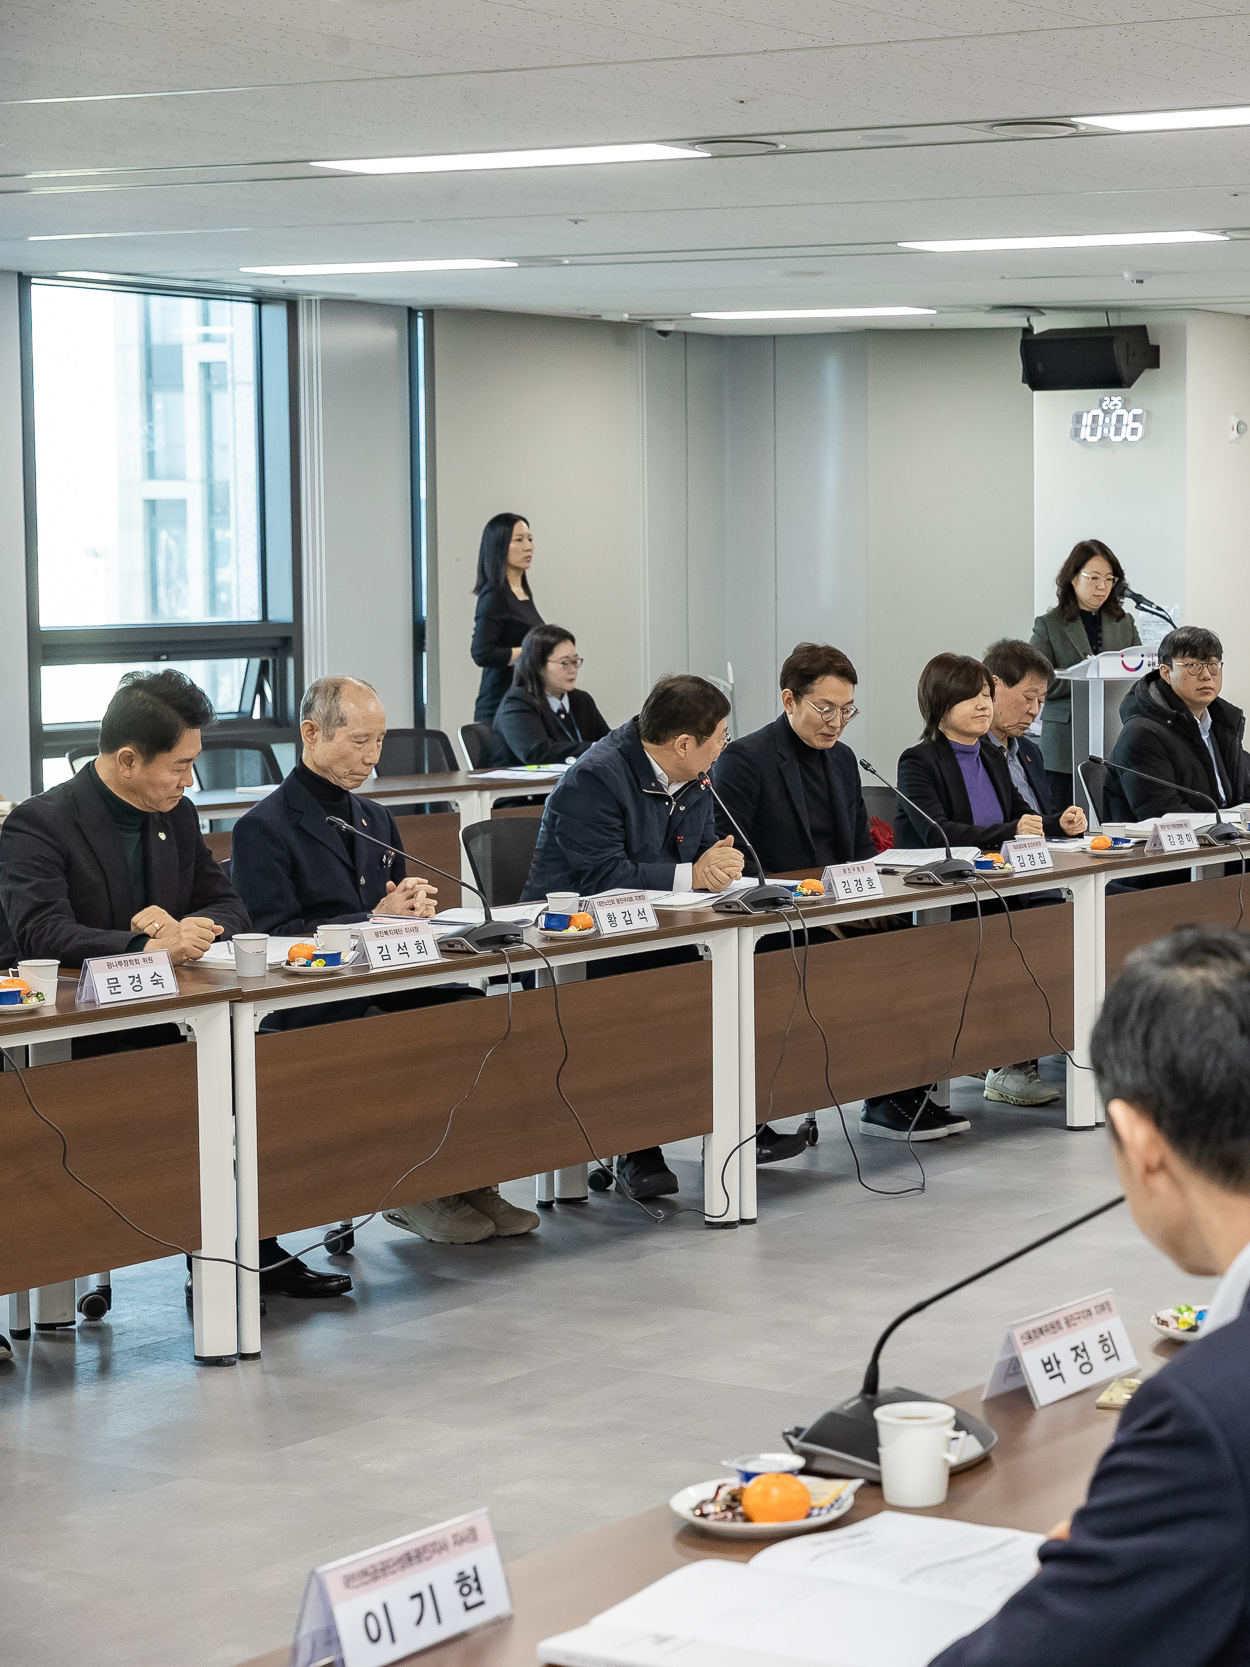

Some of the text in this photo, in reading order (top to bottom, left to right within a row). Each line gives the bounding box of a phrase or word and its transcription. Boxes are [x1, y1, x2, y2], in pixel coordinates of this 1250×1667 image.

[1079, 408, 1144, 442] 10:06
[841, 876, 877, 895] 김경호
[606, 907, 649, 929] 황갑석
[404, 926, 420, 935] 이사장
[142, 956, 154, 965] 위원
[376, 939, 429, 962] 김석회
[106, 971, 165, 996] 문경숙
[1041, 1330, 1121, 1385] 박정희
[363, 1564, 486, 1645] 이기현
